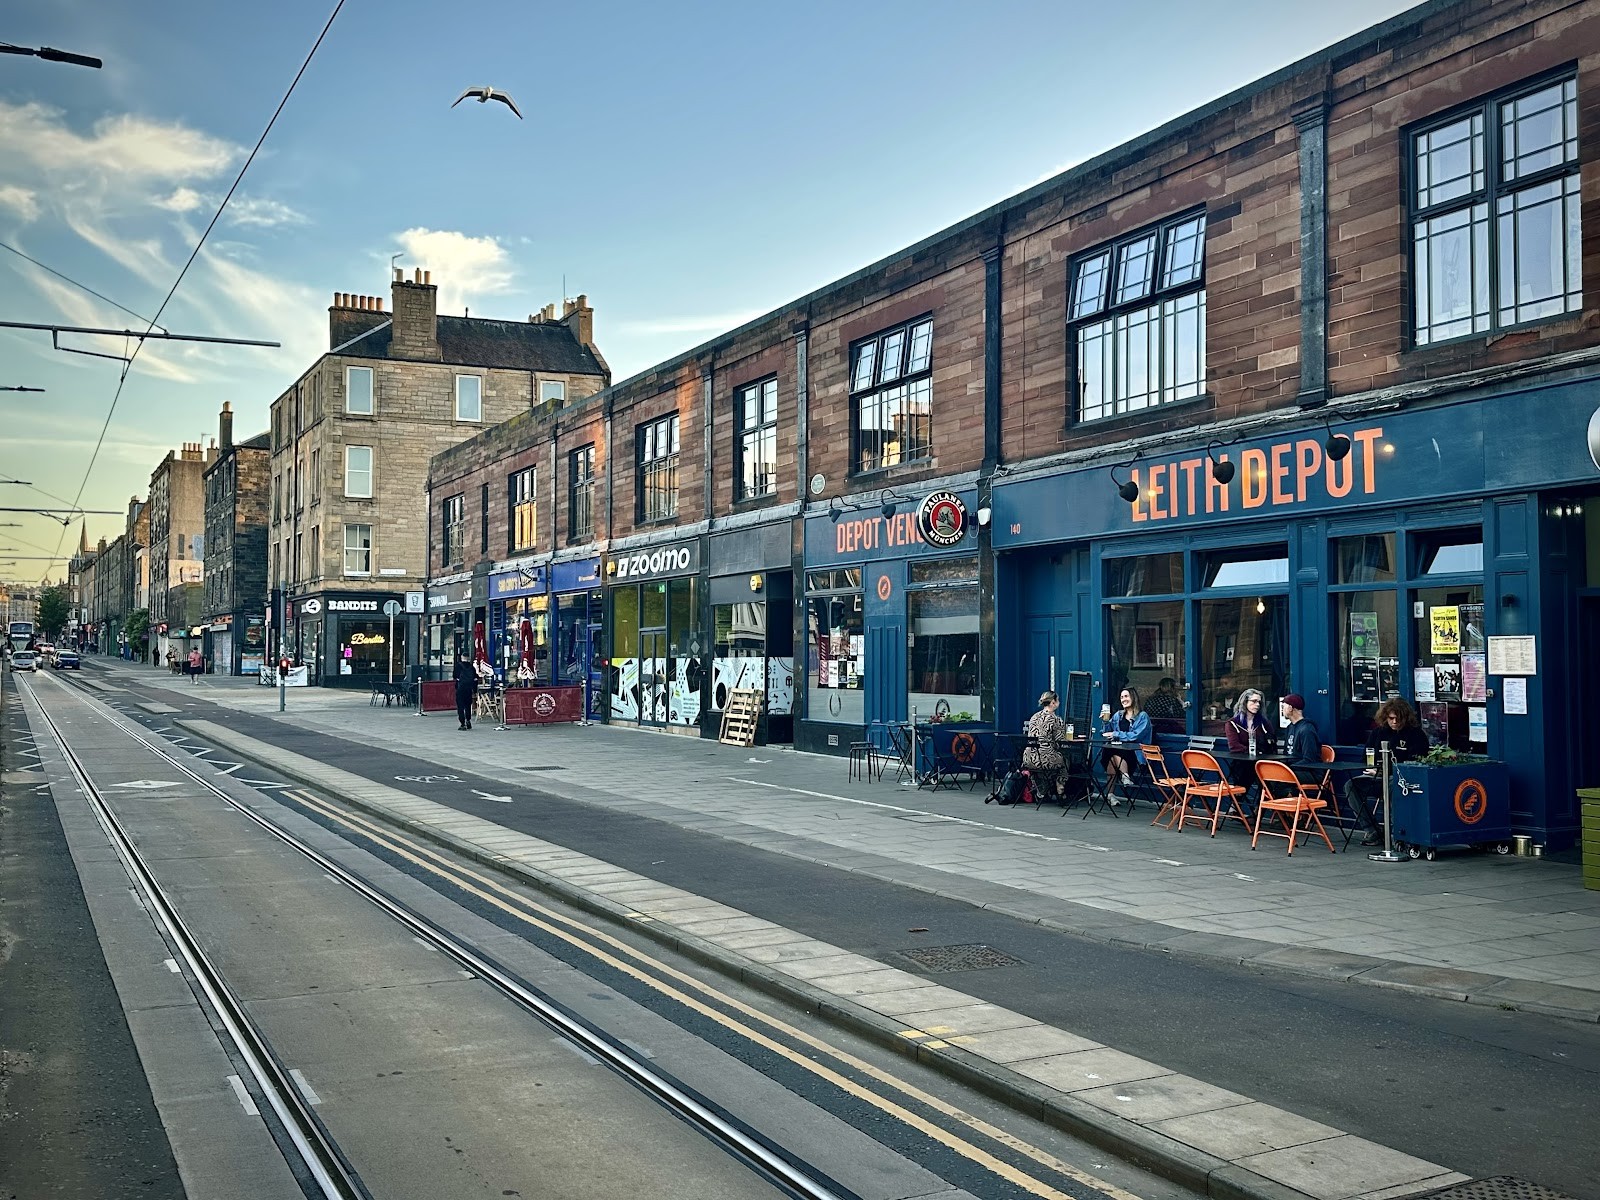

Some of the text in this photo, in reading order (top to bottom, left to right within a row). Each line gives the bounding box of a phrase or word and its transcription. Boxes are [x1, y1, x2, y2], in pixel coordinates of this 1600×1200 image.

[1131, 427, 1384, 522] LEITH DEPOT
[924, 493, 966, 513] PAULANER
[837, 517, 882, 553] DEPOT
[1010, 522, 1021, 535] 140
[629, 547, 690, 576] zoomo
[328, 600, 378, 611] BANDITS
[350, 632, 386, 645] Bandits
